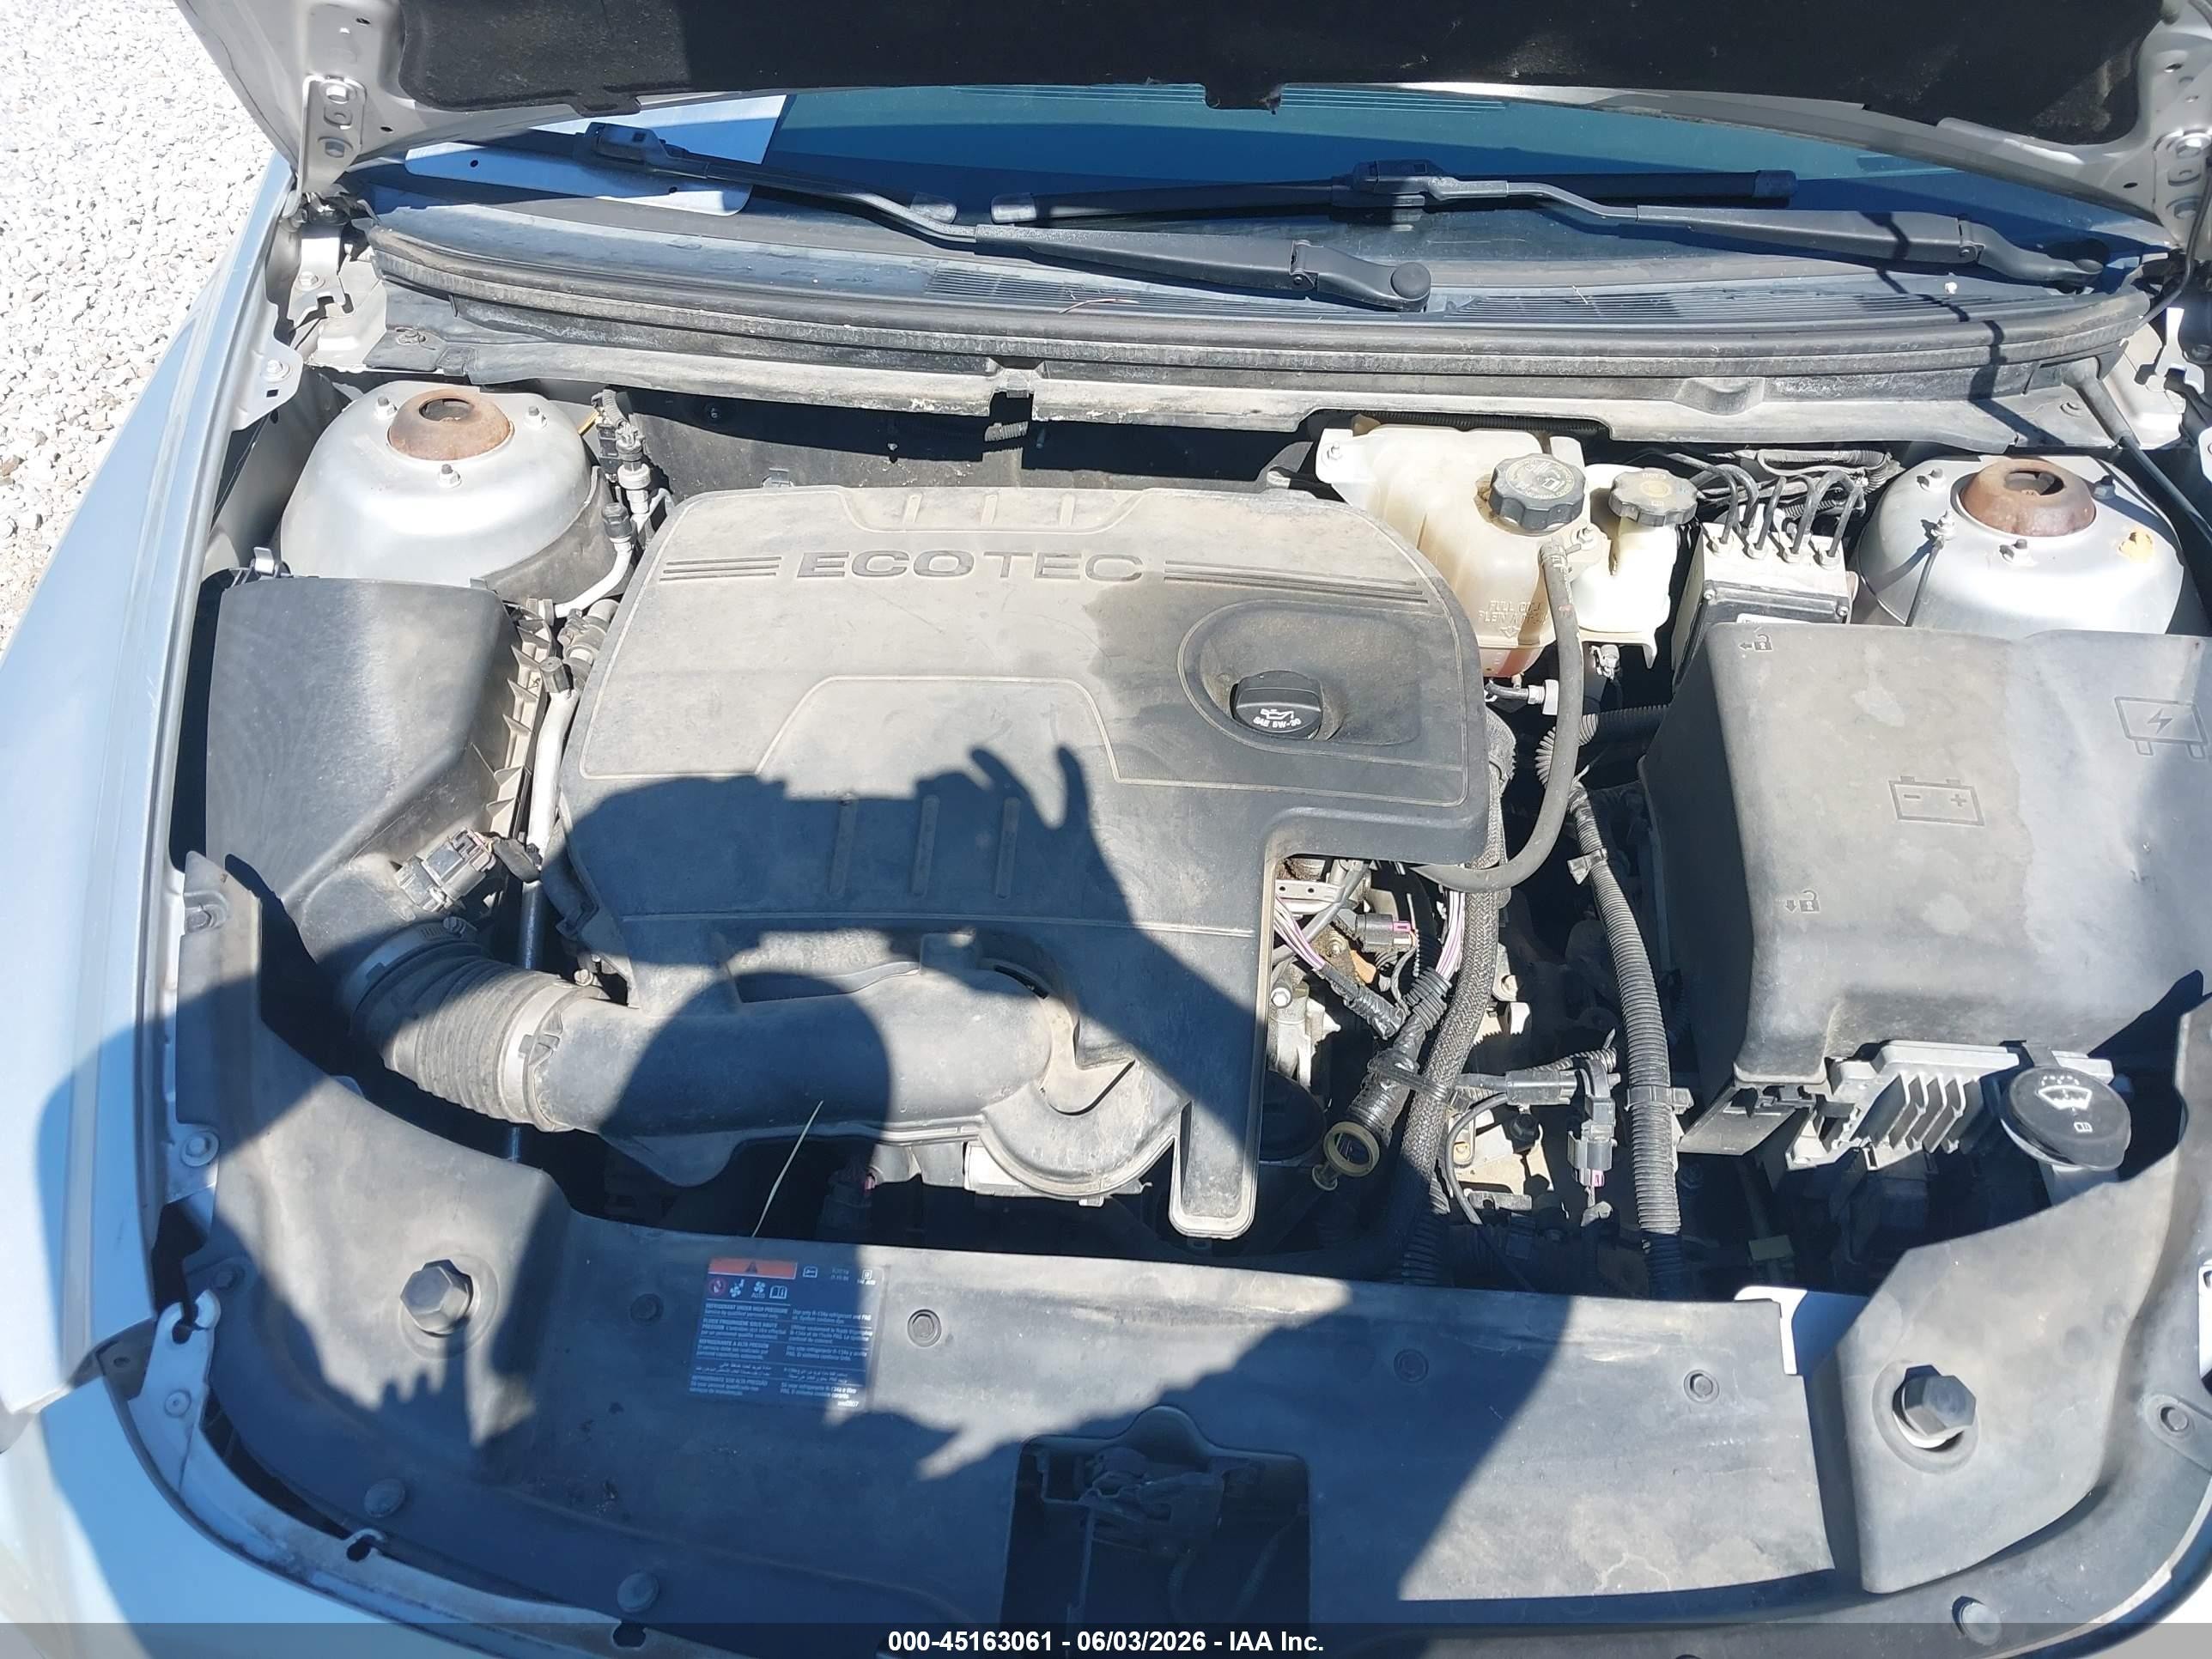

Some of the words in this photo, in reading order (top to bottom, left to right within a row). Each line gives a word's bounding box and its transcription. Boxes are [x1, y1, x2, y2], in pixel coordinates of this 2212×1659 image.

[796, 550, 1144, 582] ECOTEC
[1253, 716, 1270, 727] SAE
[1273, 718, 1302, 728] 5W-30
